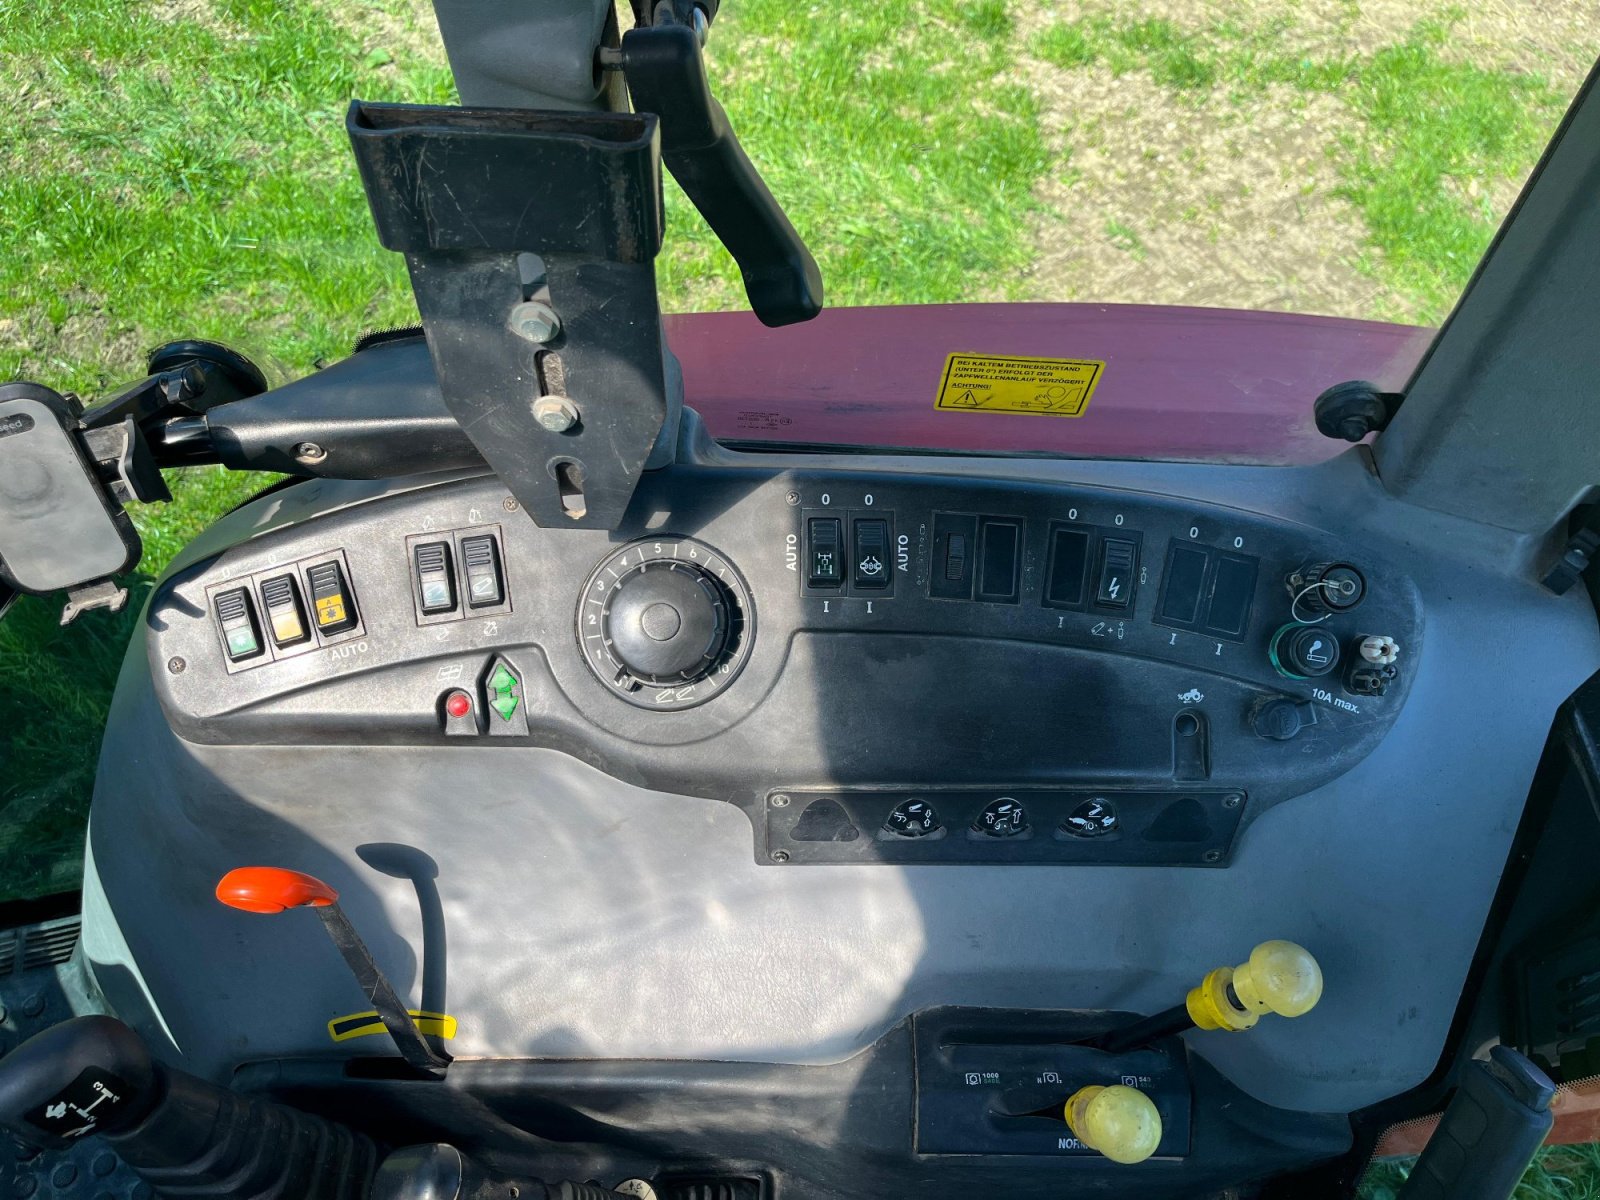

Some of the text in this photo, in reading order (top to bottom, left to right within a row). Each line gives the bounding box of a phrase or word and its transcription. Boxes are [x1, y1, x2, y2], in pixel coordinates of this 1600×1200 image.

[998, 369, 1035, 377] ERFOLGT
[1005, 363, 1081, 372] BETRIEBSZUSTAND
[953, 373, 1086, 385] ZAPFWELLENANLAUF VERZÖGERT
[654, 542, 662, 554] 5
[689, 548, 698, 559] 6
[785, 533, 797, 572] AUTO
[898, 534, 909, 572] AUTO
[620, 555, 628, 566] 4
[718, 568, 726, 578] 7
[597, 580, 605, 591] 3
[588, 614, 597, 625] 2
[331, 641, 369, 661] AUTO
[595, 649, 602, 660] 1
[717, 663, 730, 674] 10
[1312, 687, 1361, 715] 10A max.
[92, 1081, 104, 1092] 3
